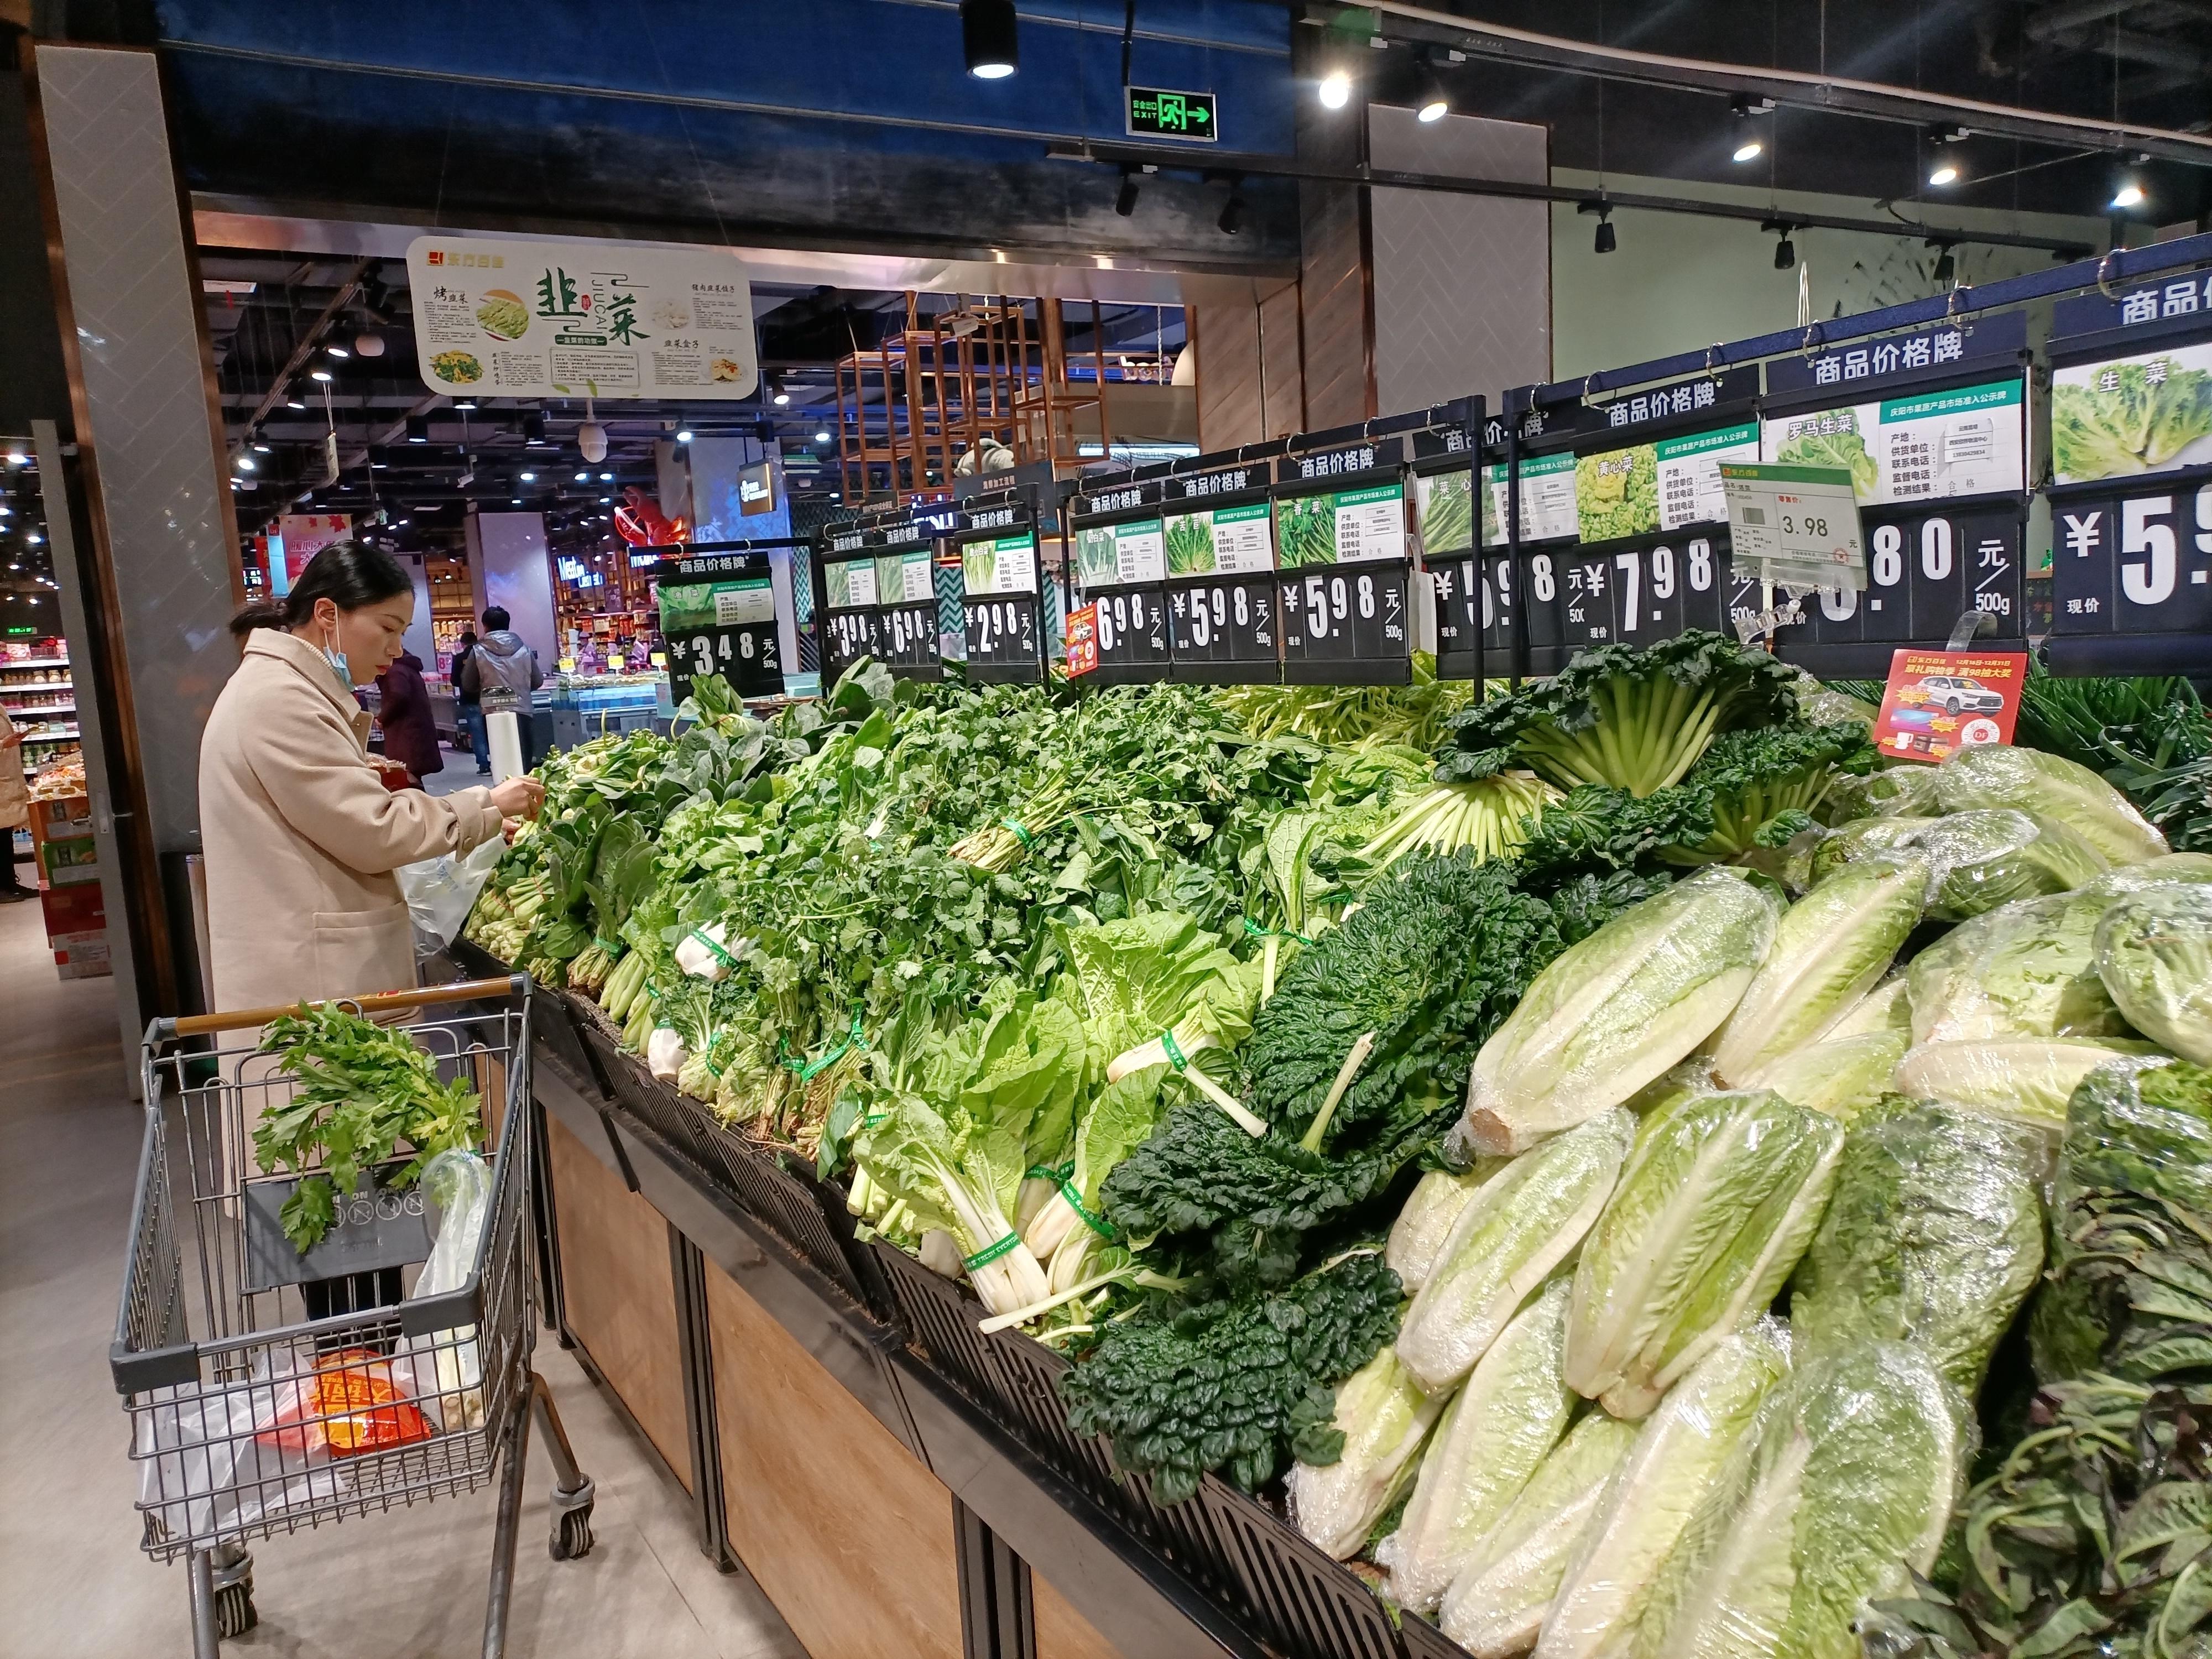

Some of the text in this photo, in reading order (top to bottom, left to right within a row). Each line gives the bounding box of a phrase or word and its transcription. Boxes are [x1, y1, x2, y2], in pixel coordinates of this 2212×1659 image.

[1134, 111, 1157, 119] EXIT
[591, 279, 608, 330] JIUCAI
[1816, 331, 1964, 385] 商品价格牌
[2098, 358, 2168, 394] 生菜
[1610, 382, 1715, 427] 商品价格牌
[1446, 415, 1544, 452] 商价牌
[1788, 415, 1853, 441] 罗马生菜
[1301, 448, 1374, 478] 商品价格牌
[1598, 455, 1634, 477] 黄心菜
[1185, 470, 1246, 496] 商品价格牌
[1439, 478, 1472, 495] 菜心
[1091, 489, 1142, 513] 商品价格牌
[1294, 501, 1321, 516] 香菜
[972, 509, 1014, 529] 商品价格牌
[1783, 515, 1828, 536] 3.98
[833, 535, 864, 551] 商品价格牌
[886, 526, 919, 544] 商品价格牌
[1849, 539, 1858, 548] 元
[679, 556, 747, 573] 商品价格牌
[2067, 597, 2100, 614] 现价
[1288, 635, 1301, 646] 现价
[1441, 627, 1458, 637] 现价
[1590, 627, 1608, 639] 现价
[1178, 640, 1190, 649] 现价
